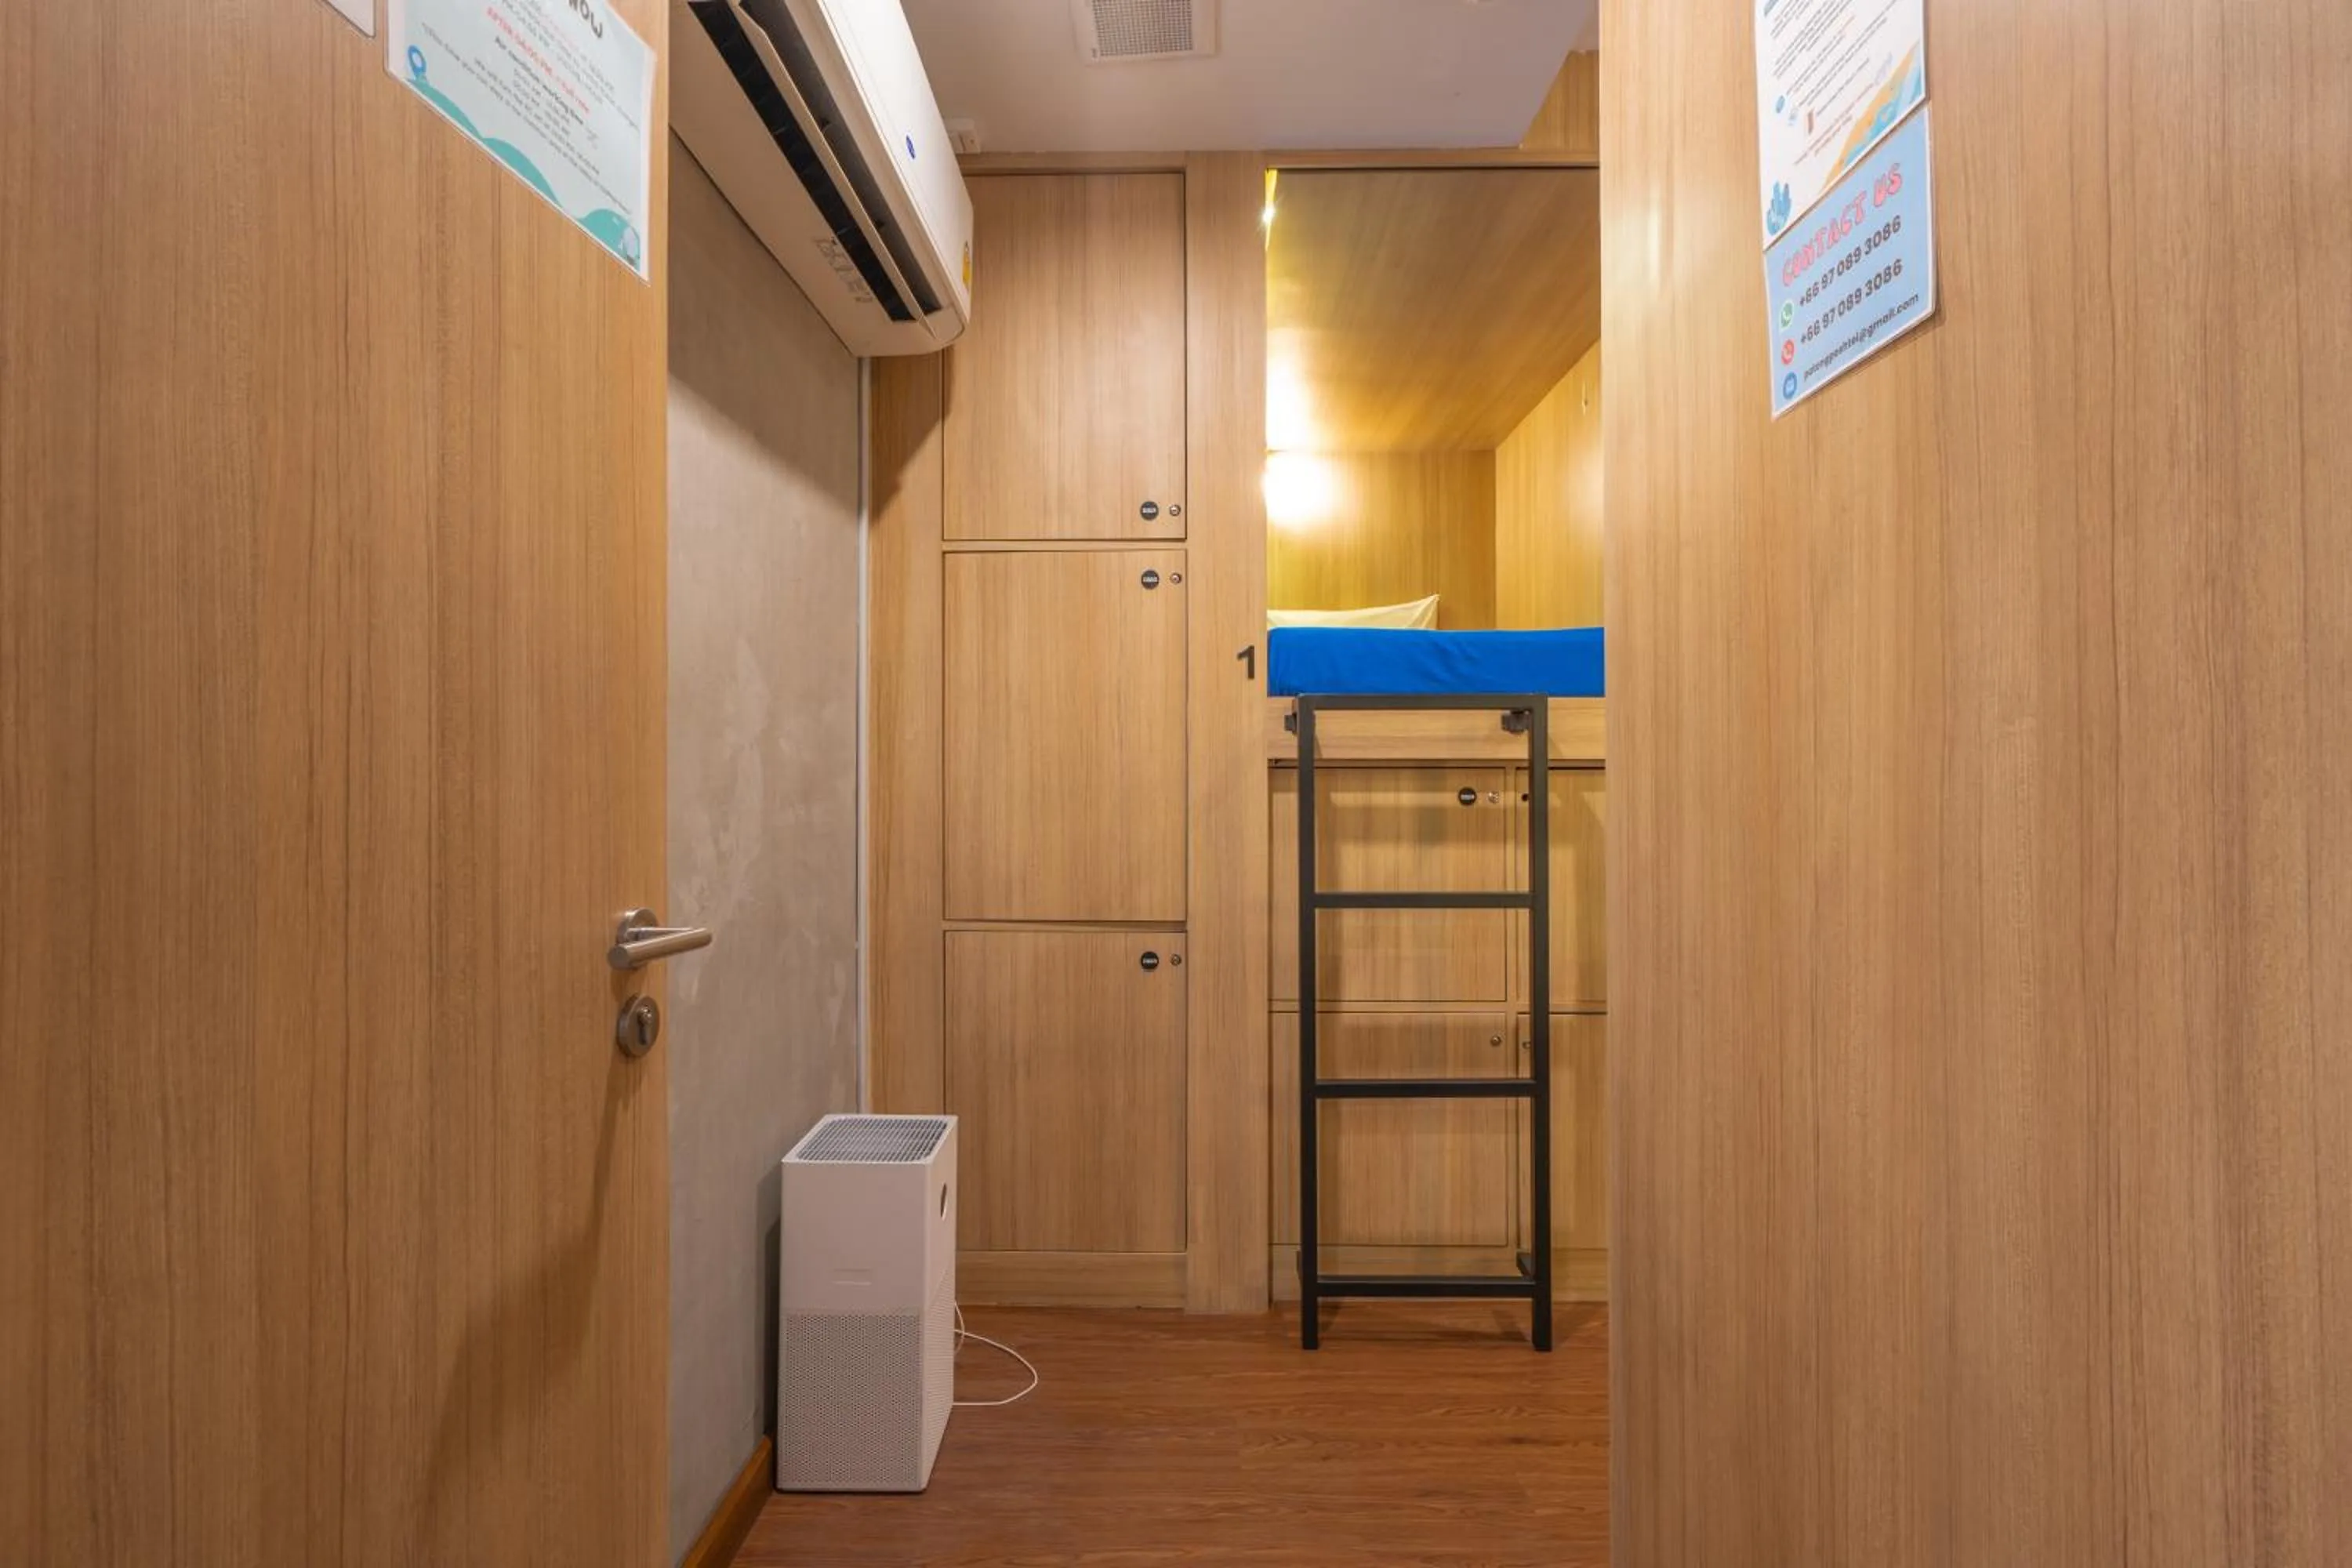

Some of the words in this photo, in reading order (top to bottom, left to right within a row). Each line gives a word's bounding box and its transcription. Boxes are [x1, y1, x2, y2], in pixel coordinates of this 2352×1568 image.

[1782, 191, 1867, 287] CONTACT
[1873, 162, 1903, 208] US
[1821, 267, 1835, 289] 97
[1837, 245, 1862, 277] 089
[1864, 214, 1901, 256] 3086
[1822, 307, 1836, 329] 97
[1838, 288, 1862, 318] 089
[1864, 258, 1903, 297] 3086
[1236, 644, 1255, 681] 1
